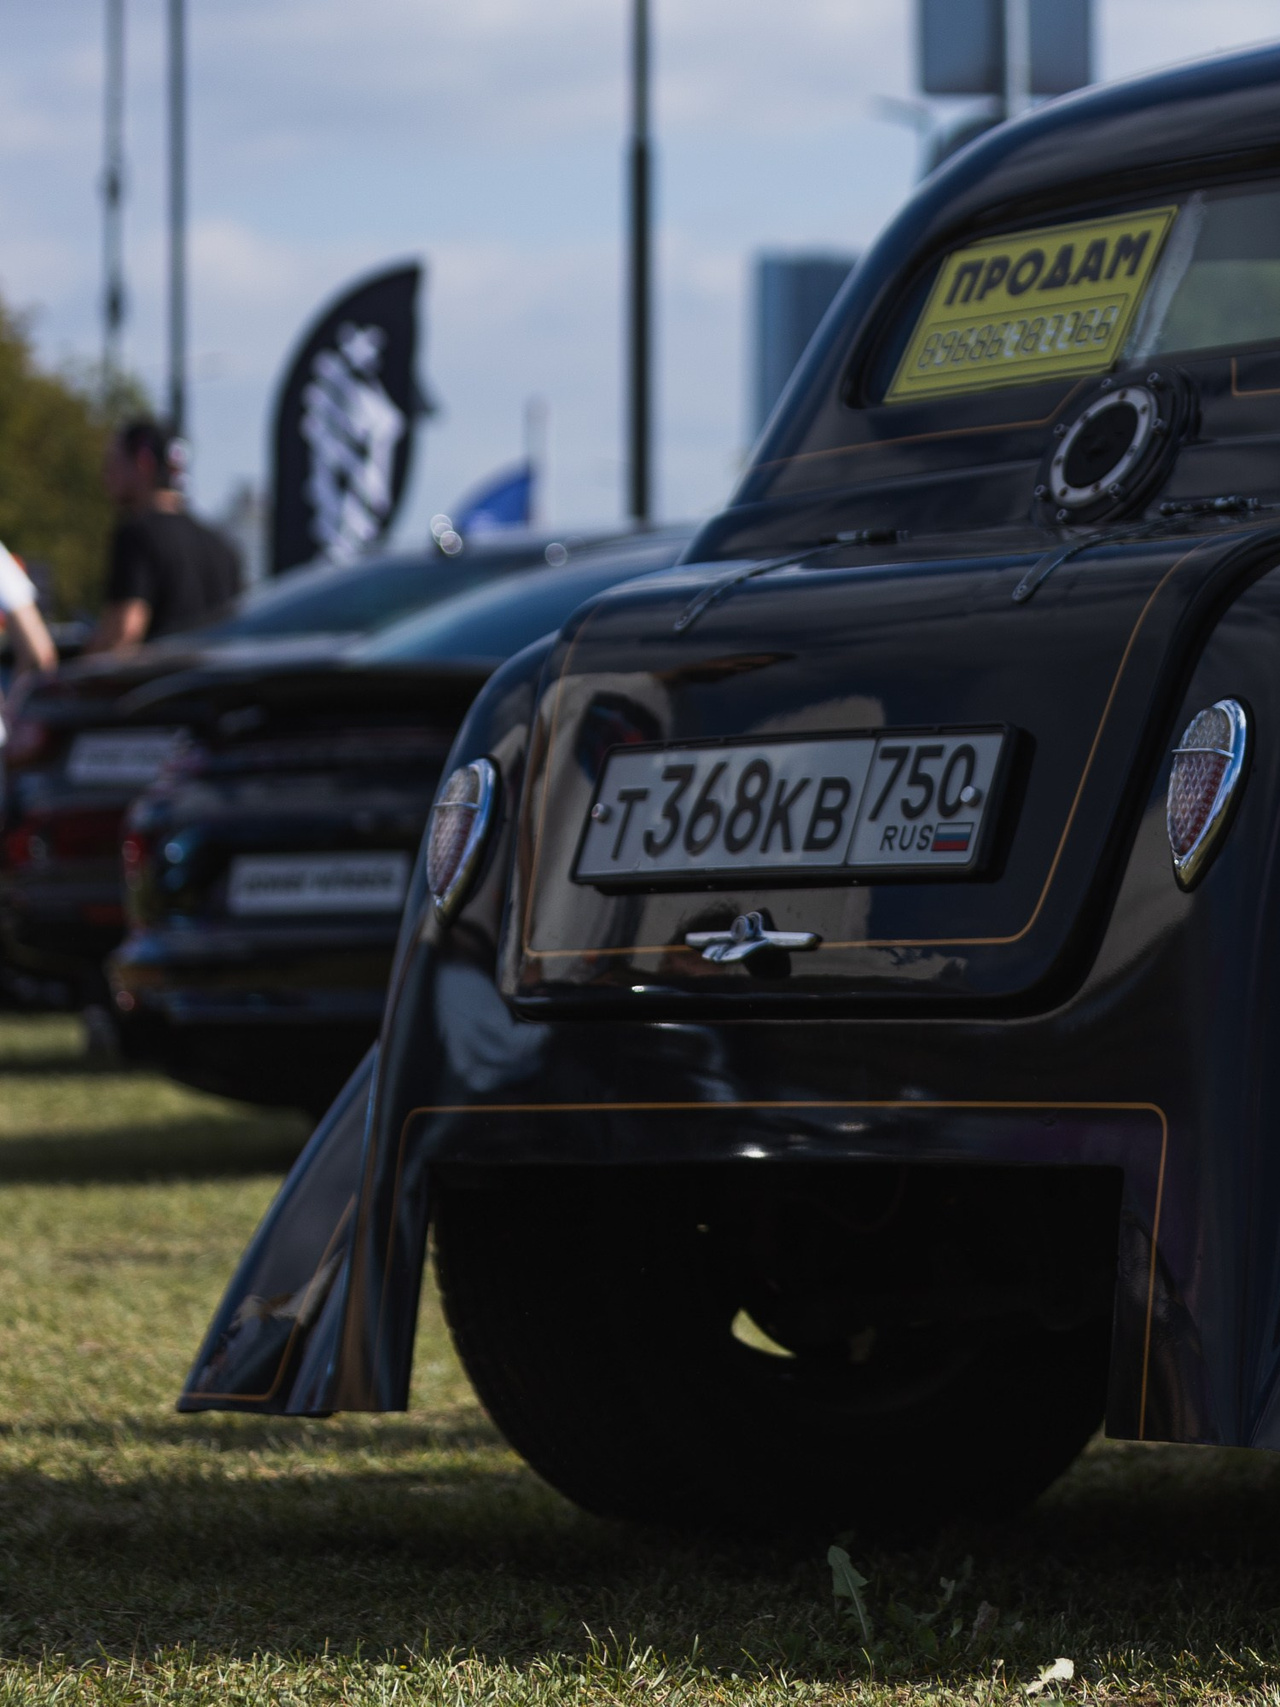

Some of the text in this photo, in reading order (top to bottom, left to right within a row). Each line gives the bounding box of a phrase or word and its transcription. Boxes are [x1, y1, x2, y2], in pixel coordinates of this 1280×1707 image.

[945, 230, 1151, 305] ПРОДАМ
[868, 744, 976, 821] 750
[879, 825, 933, 852] RUS
